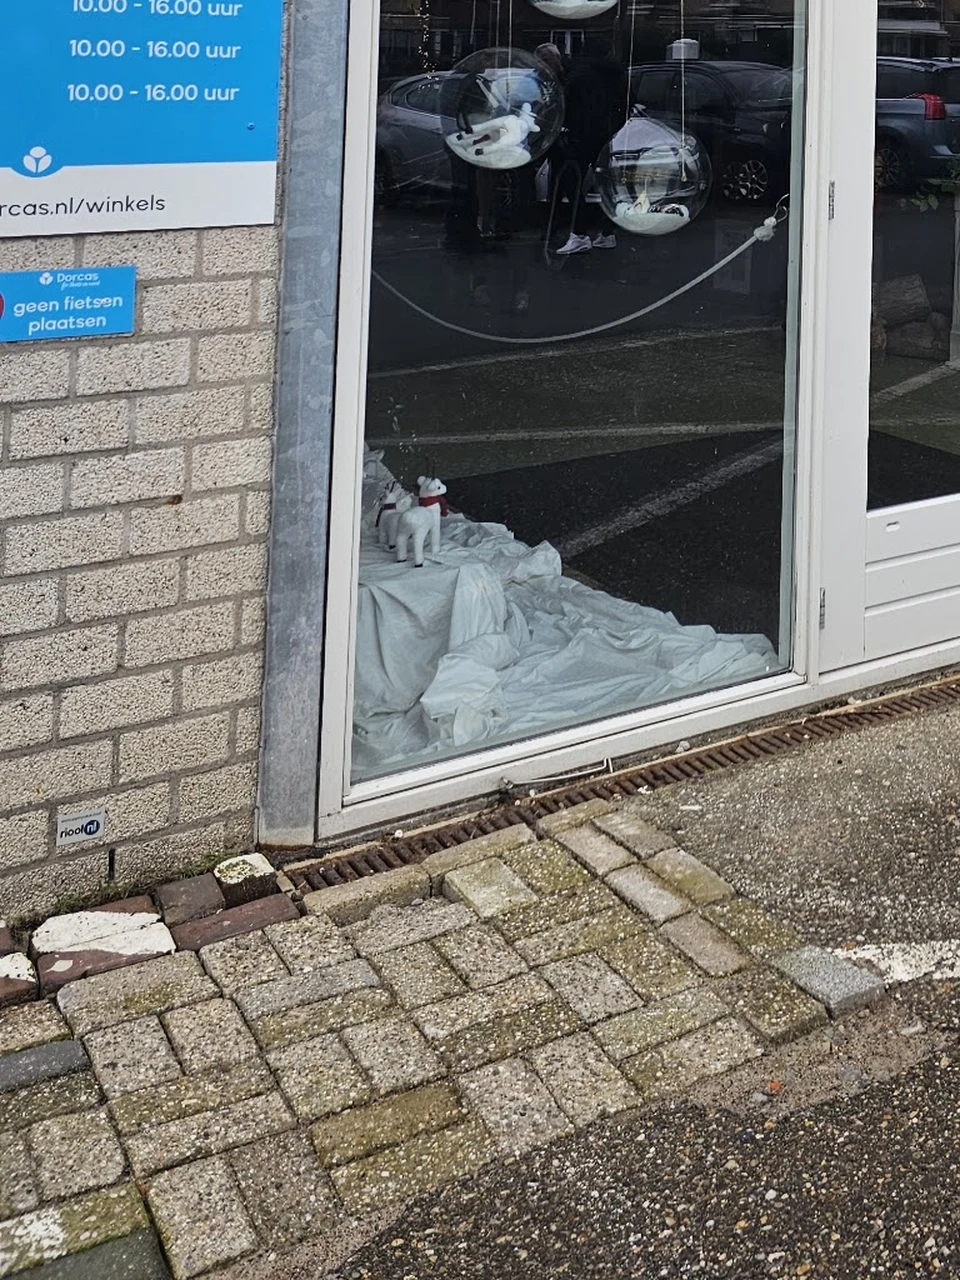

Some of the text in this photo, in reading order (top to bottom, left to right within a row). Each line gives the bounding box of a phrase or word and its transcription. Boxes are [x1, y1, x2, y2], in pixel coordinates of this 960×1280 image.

[207, 2, 243, 17] uur
[69, 39, 126, 58] 10.00
[147, 41, 200, 58] 16.00
[206, 45, 242, 59] uur
[67, 83, 124, 102] 10.00
[144, 84, 199, 102] 16.00
[204, 87, 240, 101] uur
[57, 272, 99, 282] Dorcas
[13, 295, 123, 317] geen fietsen
[28, 316, 107, 336] plaatsen
